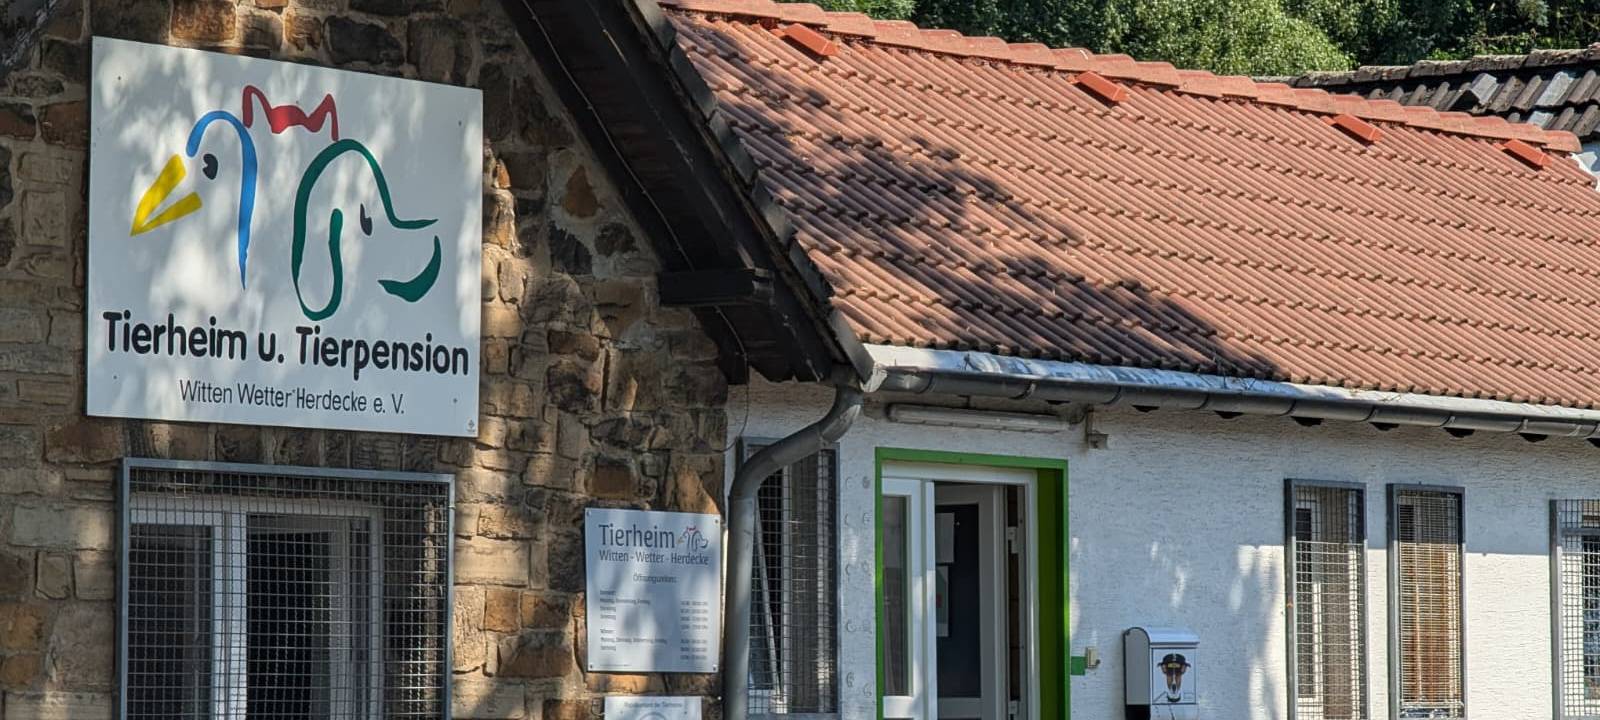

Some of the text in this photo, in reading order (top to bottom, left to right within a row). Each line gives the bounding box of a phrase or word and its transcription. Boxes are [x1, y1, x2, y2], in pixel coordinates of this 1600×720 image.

[102, 309, 469, 382] Tierheim u. Tierpension
[179, 378, 405, 415] Witten Wetter Herdecke e. V.
[598, 523, 675, 549] Tierheim
[599, 550, 629, 563] Witten
[635, 551, 665, 564] Wetter
[671, 552, 709, 566] Herdecke
